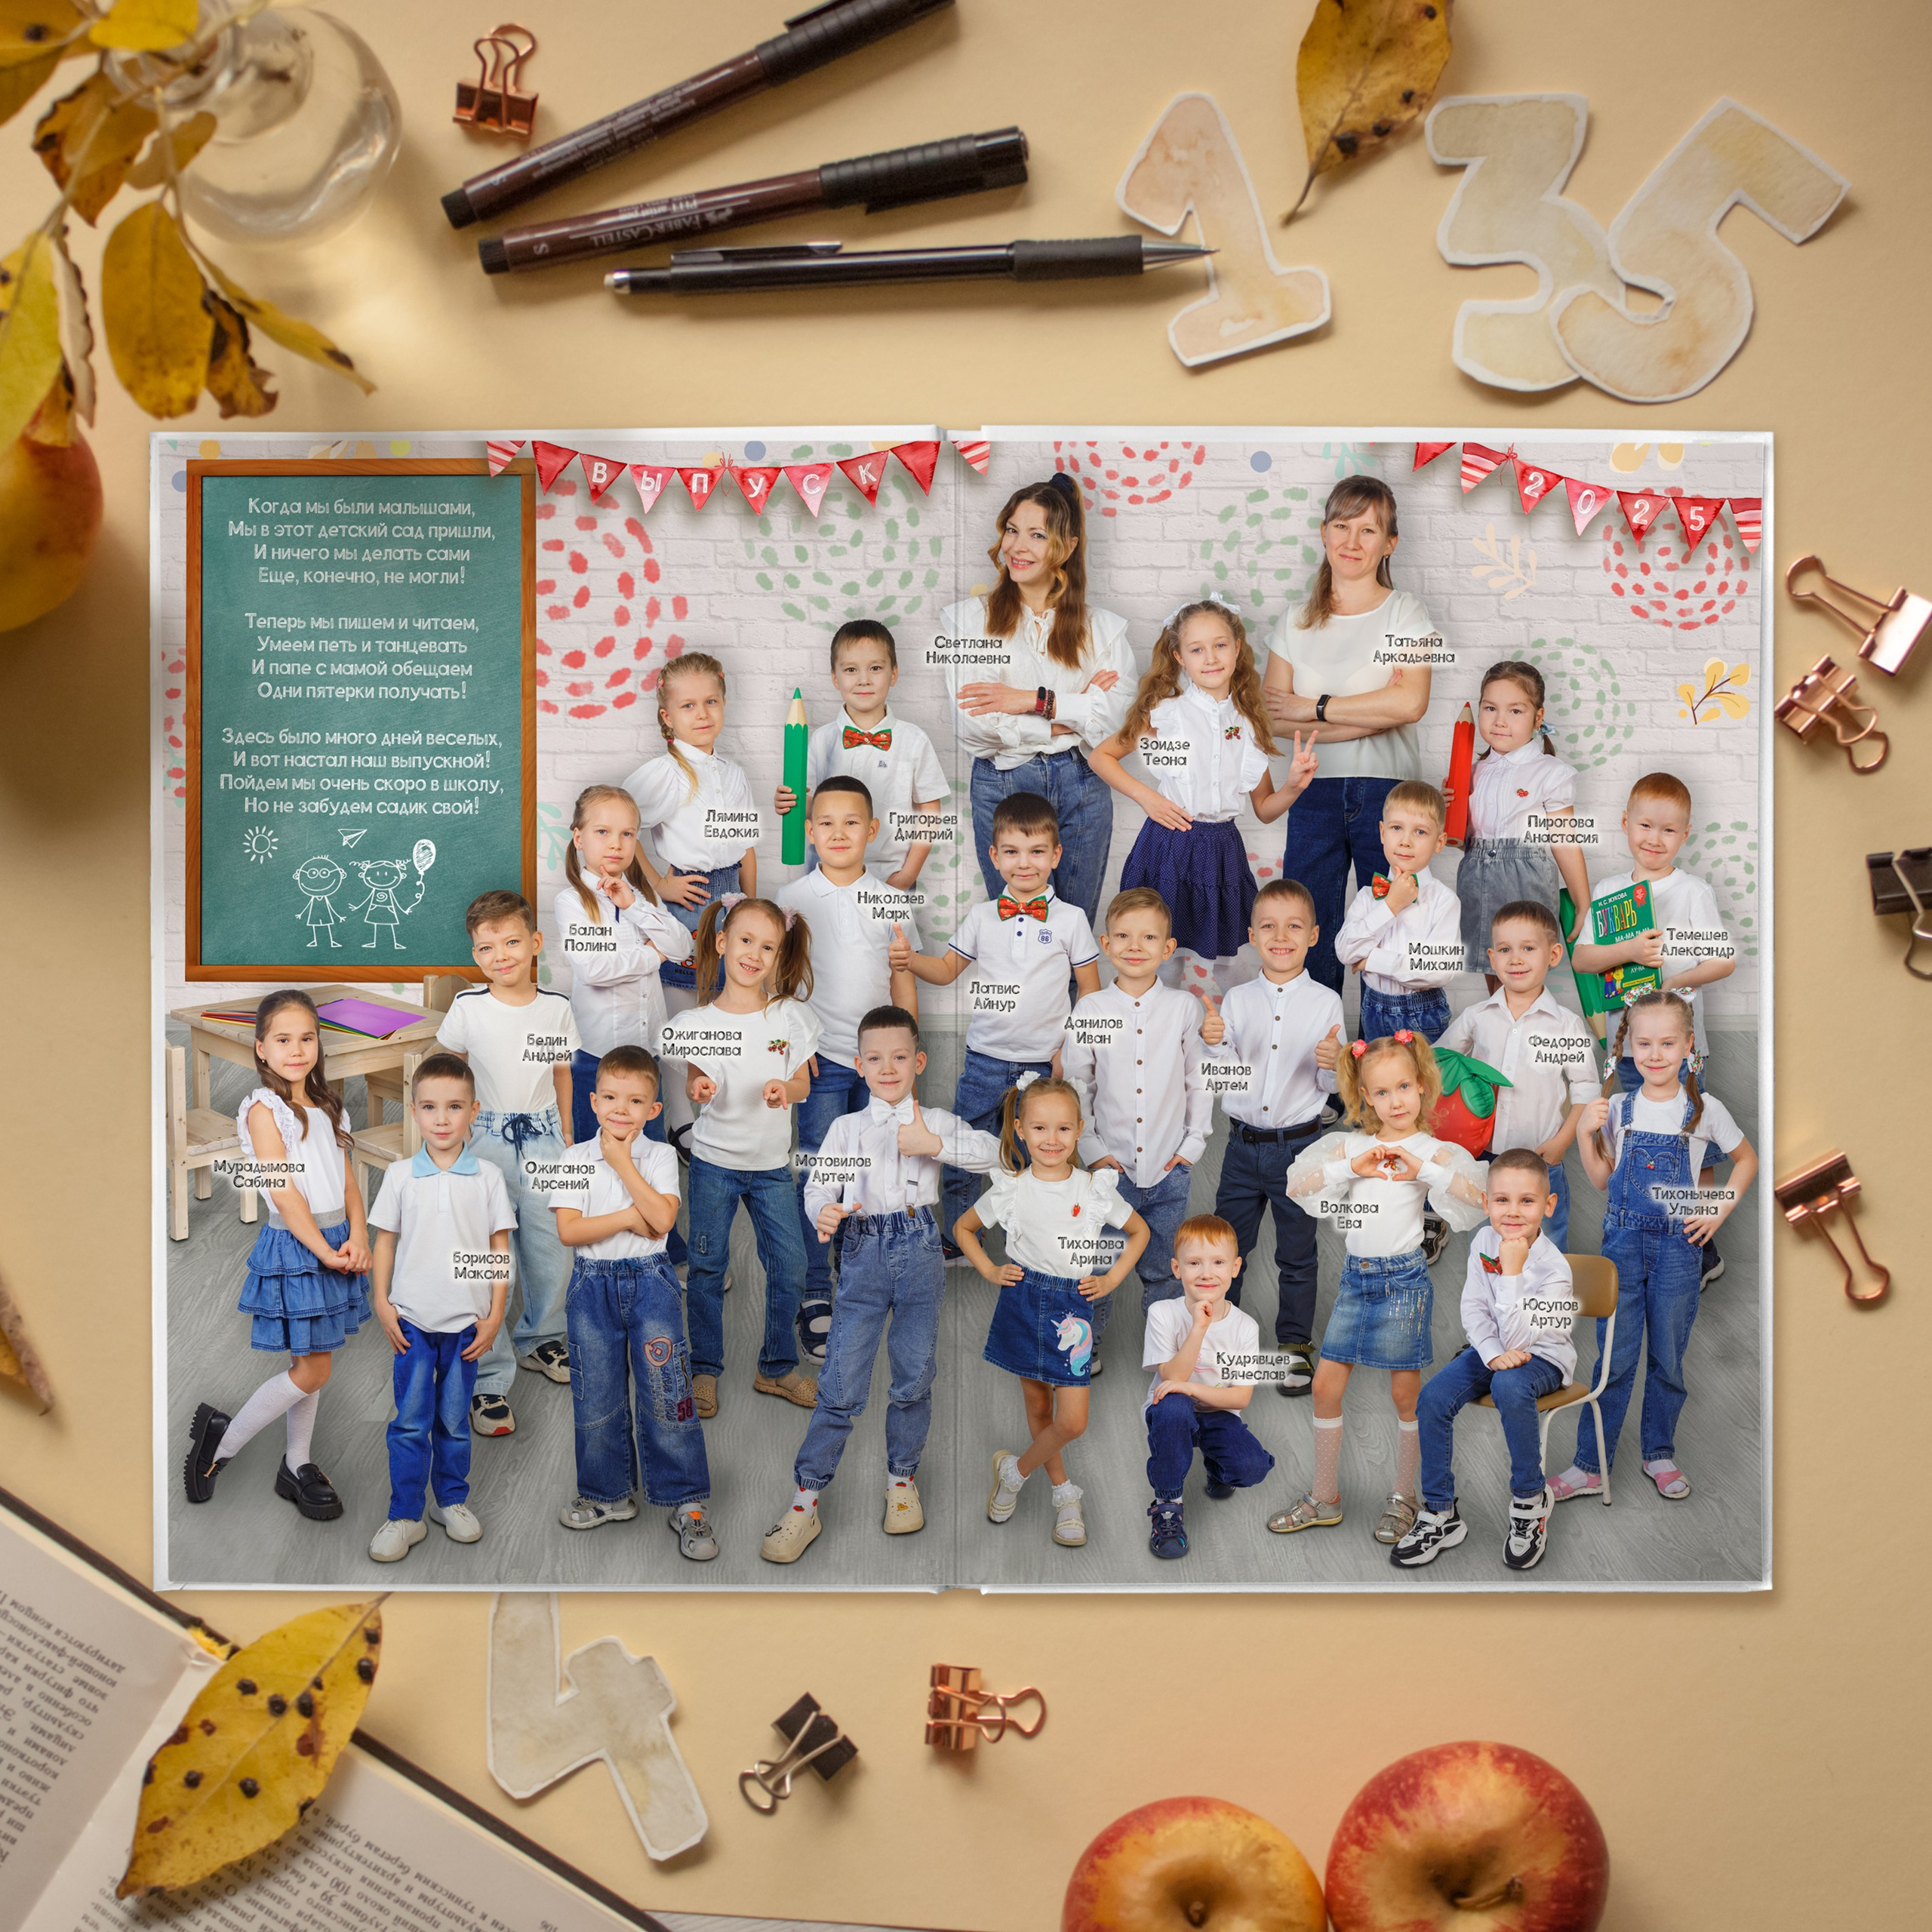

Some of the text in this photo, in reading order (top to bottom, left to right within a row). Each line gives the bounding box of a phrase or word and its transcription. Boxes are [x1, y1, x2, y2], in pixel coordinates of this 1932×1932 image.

[589, 214, 702, 248] FABER-CASTELL
[532, 242, 549, 256] S
[592, 463, 876, 500] ВЫПУСК
[248, 498, 475, 519] Когда мы были малышами,
[1524, 472, 1706, 532] 2025
[228, 521, 496, 543] Мы в этот детский сад пришли,
[254, 543, 470, 563] И ничего мы делать сами
[258, 566, 466, 587] Еще, конечно, не могли!
[244, 613, 479, 634] Теперь мы пишем и читаем,
[257, 636, 468, 656] Умеем петь и танцевать
[251, 659, 473, 679] И папе с мамой обещаем
[257, 681, 466, 703] Одни пятерки получать!
[221, 728, 503, 749] Здесь было много дней веселых,
[233, 750, 491, 772] И вот настал наш выпускной!
[220, 774, 504, 795] Пойдем мы очень скоро в школу,
[244, 796, 479, 817] Но не забудем садик свой!
[1608, 892, 1627, 903] ЖУКОВА
[1596, 899, 1638, 937] БУКВАРЬ
[677, 1397, 694, 1422] 58
[10, 1600, 125, 1672] датируются концом
[0, 1610, 116, 1687] юношей-факелоносц
[7, 1635, 64, 1674] статуэтки
[23, 1664, 73, 1698] фигурки
[38, 1692, 91, 1726] особенно
[312, 1824, 400, 1884] архитектурные
[365, 1841, 410, 1874] берегам
[303, 1856, 390, 1915] около 100 года
[414, 1872, 474, 1913] тунисским
[321, 1890, 337, 1905] 39
[360, 1875, 440, 1929] произведения
